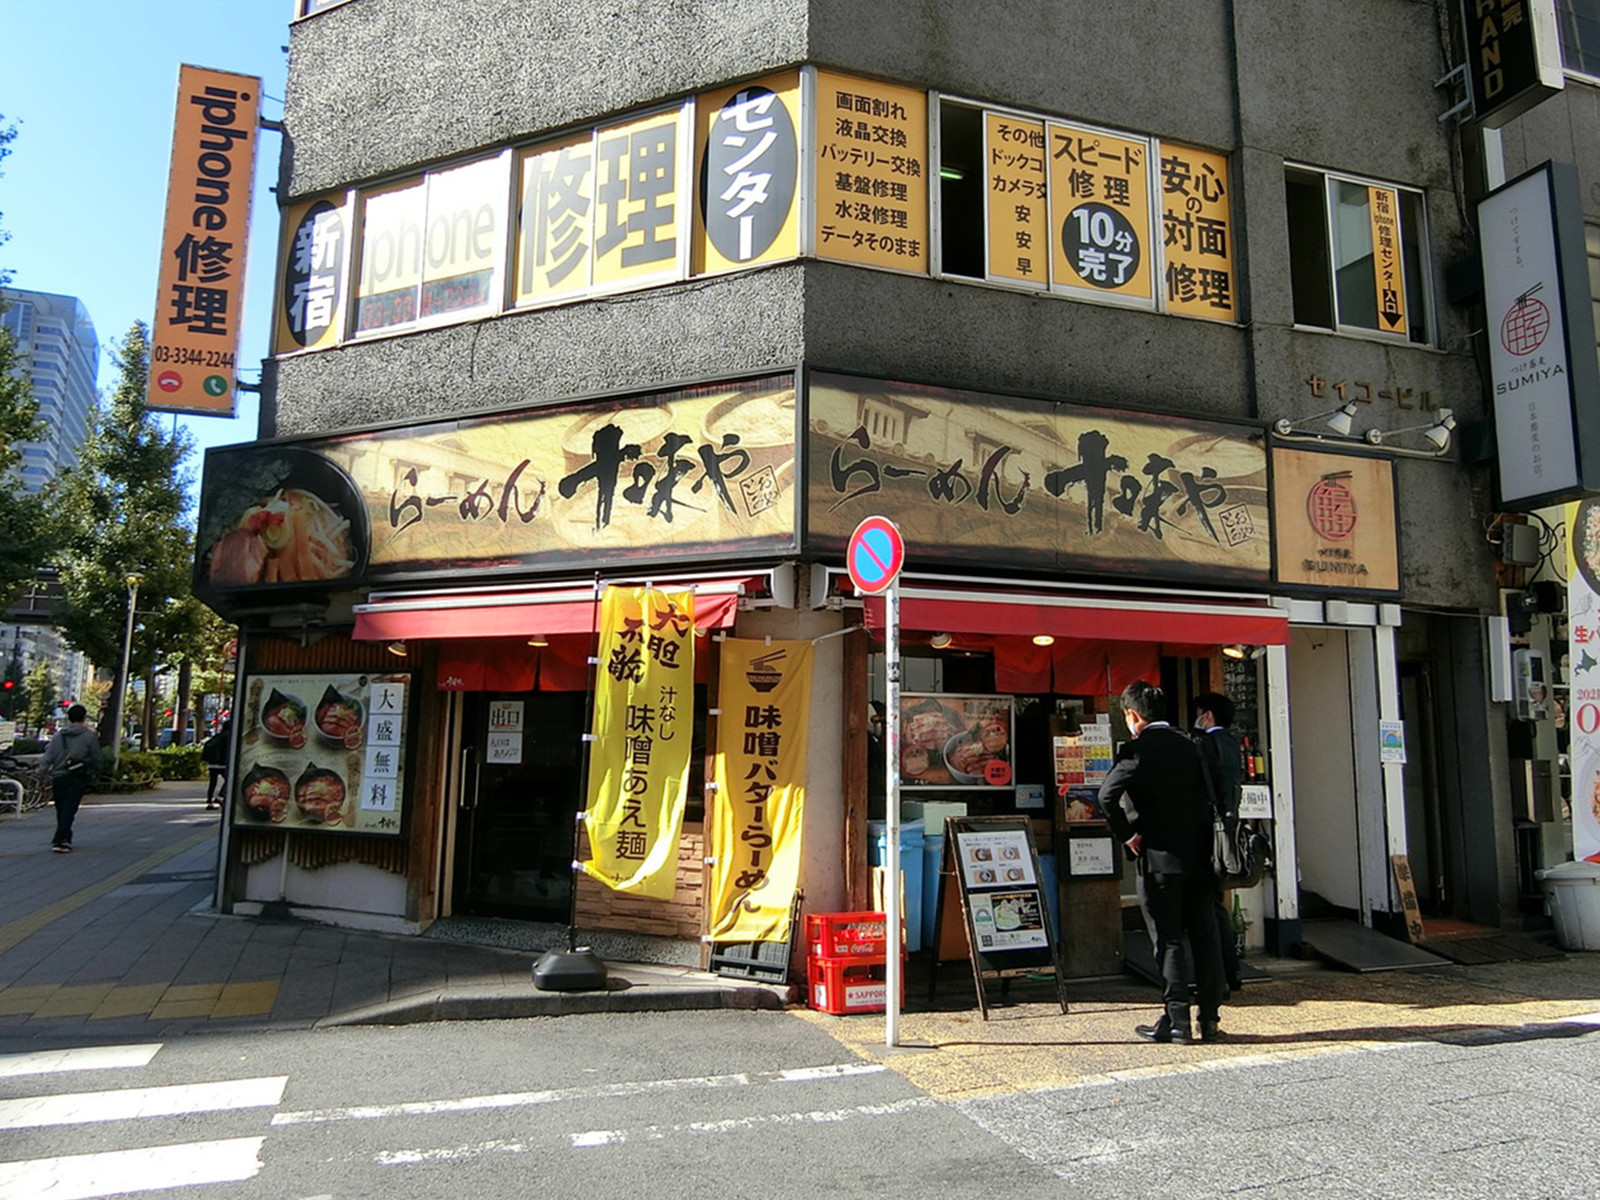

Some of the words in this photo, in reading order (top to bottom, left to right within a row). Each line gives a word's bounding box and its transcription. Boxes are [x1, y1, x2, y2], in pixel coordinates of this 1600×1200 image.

[835, 90, 908, 121] 画面割れ
[835, 117, 907, 149] 液晶交換
[997, 124, 1045, 149] その他
[821, 143, 921, 178] バッテリー交換
[992, 148, 1045, 173] ドックコ
[1053, 133, 1142, 175] スピード
[720, 92, 778, 260] センター
[835, 171, 908, 202] 基盤修理
[1068, 168, 1131, 208] 修理
[522, 122, 677, 295] 修理
[835, 200, 908, 229] 水没修理
[821, 225, 921, 258] データそのまま
[1072, 208, 1134, 253] 10分
[1162, 208, 1227, 259] 対面
[292, 211, 341, 333] 新宿
[1078, 248, 1133, 285] 完了
[1165, 261, 1232, 310] 修理
[154, 346, 235, 369] 03-3344-2244
[1307, 373, 1437, 412] セイコービル
[1496, 364, 1565, 396] SUMIYA
[385, 458, 546, 546] らーめん
[558, 422, 752, 536] 十味や
[828, 425, 1030, 516] らーめん
[1045, 429, 1228, 547] 十味や
[1303, 559, 1369, 576] SUMIYA
[607, 616, 646, 685] 不敵
[646, 603, 690, 669] 大胆
[491, 708, 520, 726] 出口
[657, 685, 679, 741] 汁なし
[369, 688, 395, 806] 大盛無料
[615, 704, 656, 861] 味噌あえ麺
[713, 704, 782, 937] 味噌バターらーめん
[1396, 863, 1422, 940] 準備中
[855, 989, 887, 1000] SAPPOR
